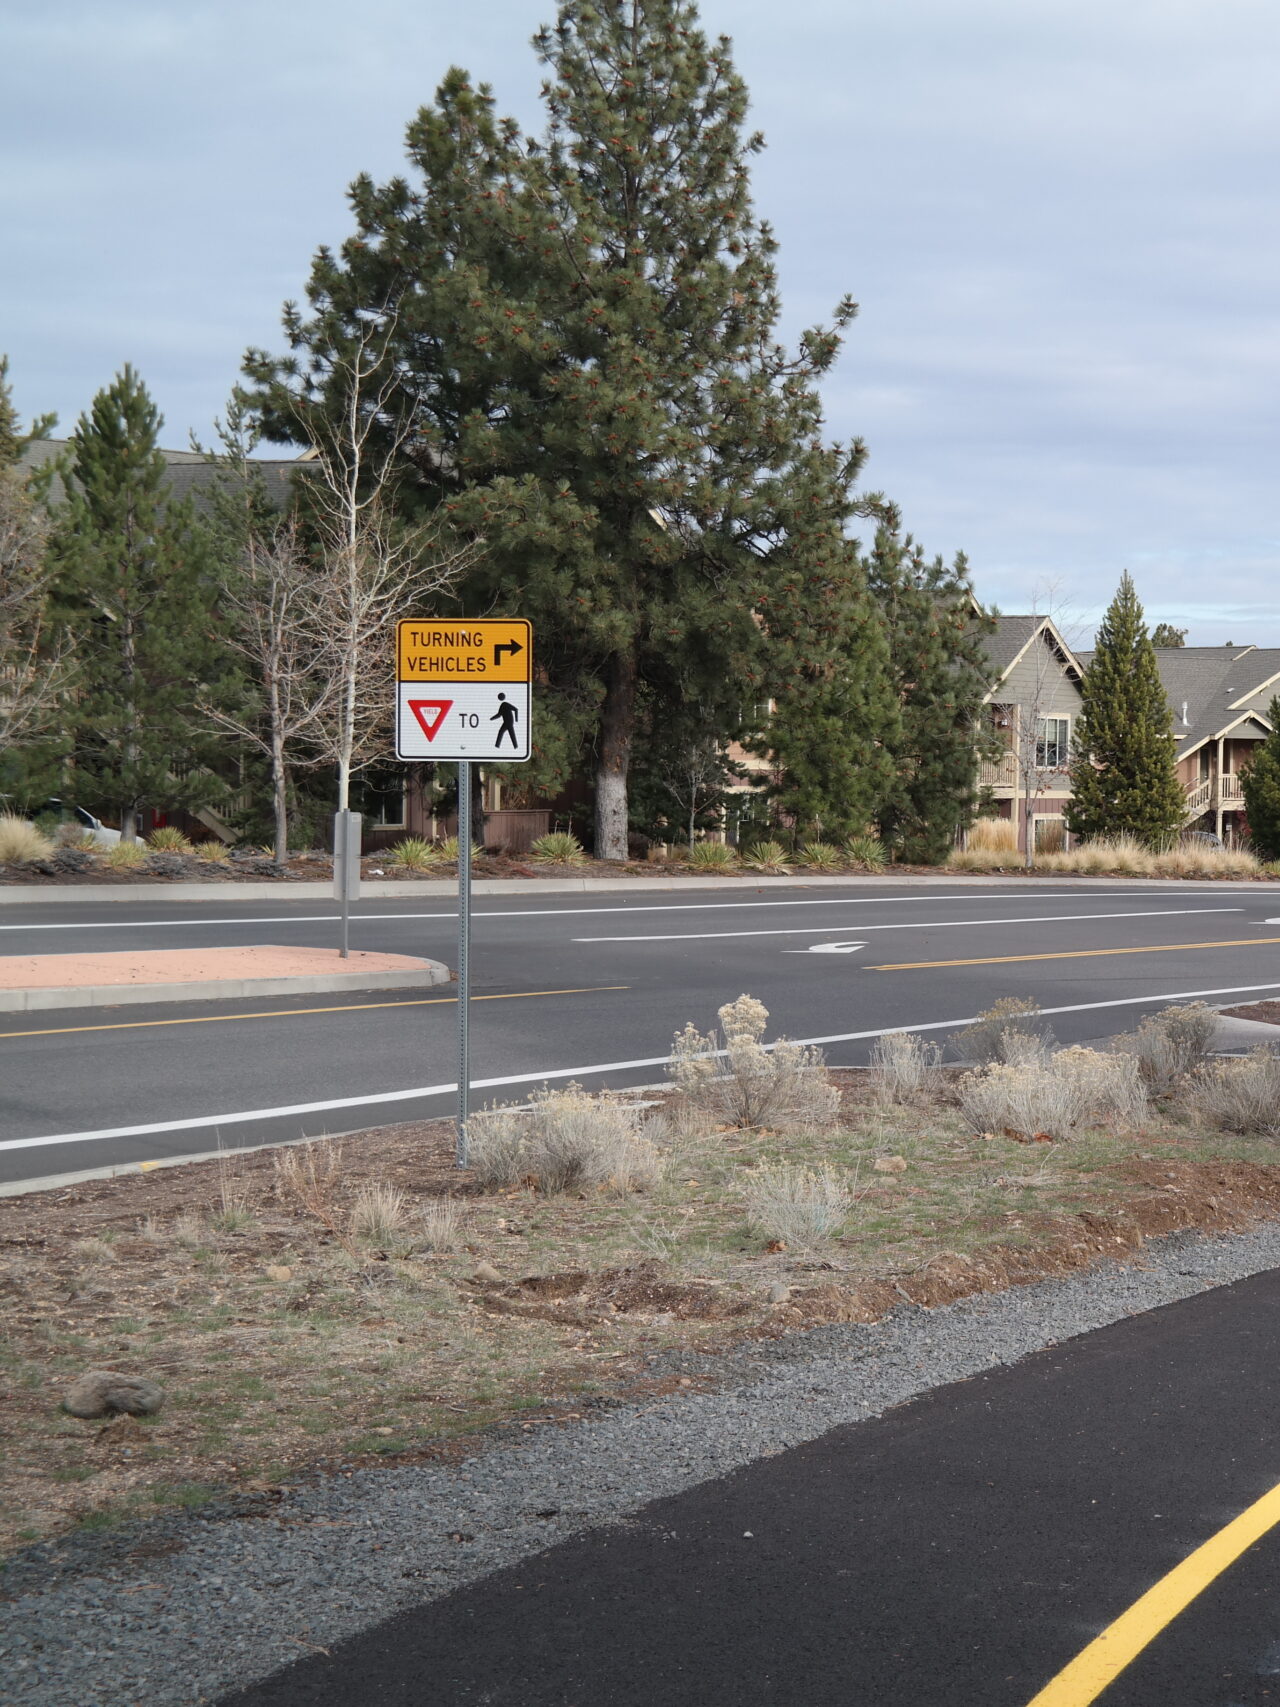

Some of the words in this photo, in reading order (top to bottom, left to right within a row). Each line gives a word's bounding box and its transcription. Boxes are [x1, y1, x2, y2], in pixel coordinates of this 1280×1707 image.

[411, 632, 483, 647] TURNING
[407, 657, 486, 672] VEHICLES
[459, 713, 479, 729] TO
